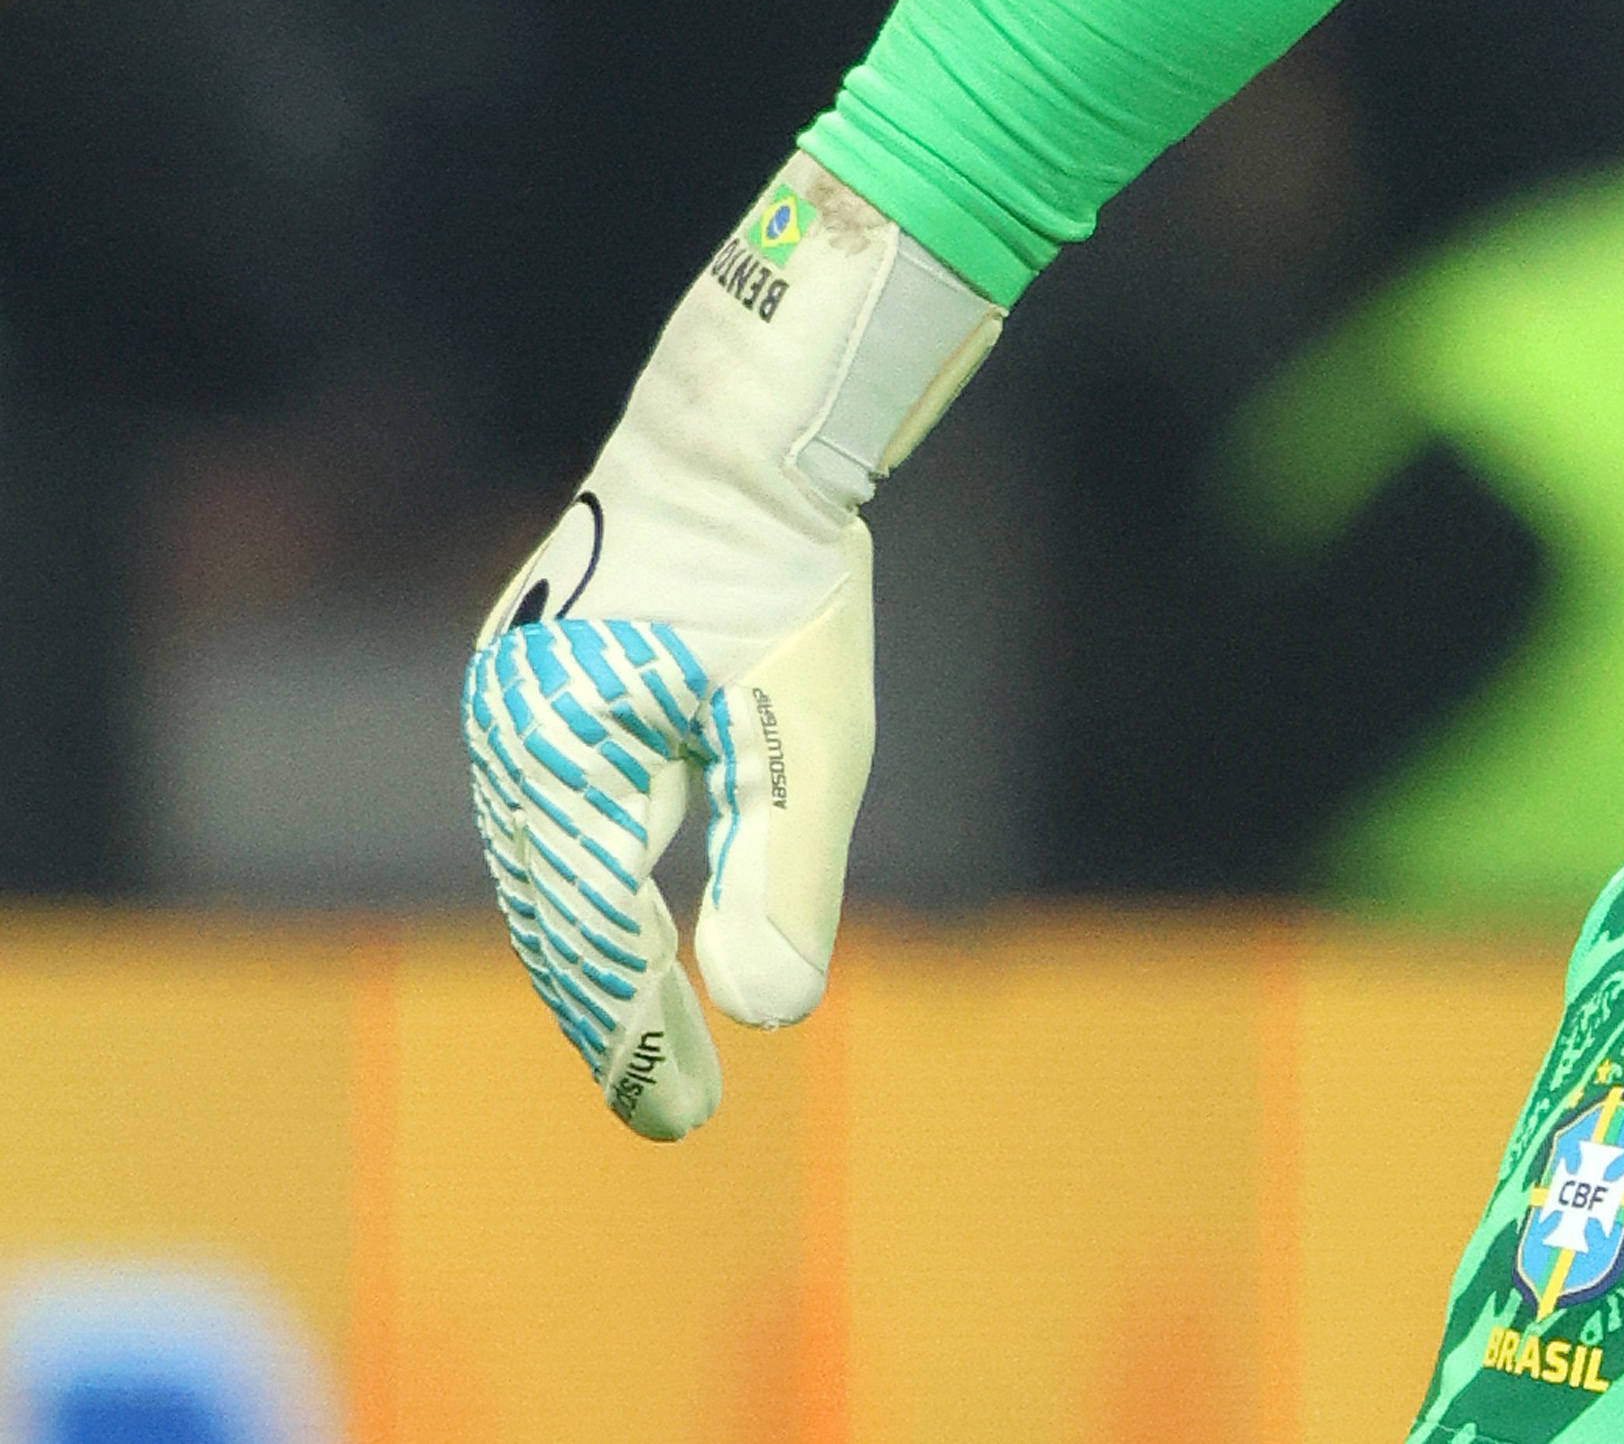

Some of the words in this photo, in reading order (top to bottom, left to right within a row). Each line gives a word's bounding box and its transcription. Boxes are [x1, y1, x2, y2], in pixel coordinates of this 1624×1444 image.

[711, 239, 789, 322] BENTO
[1558, 1181, 1608, 1210] CBF
[1483, 1327, 1610, 1393] BRASIL
